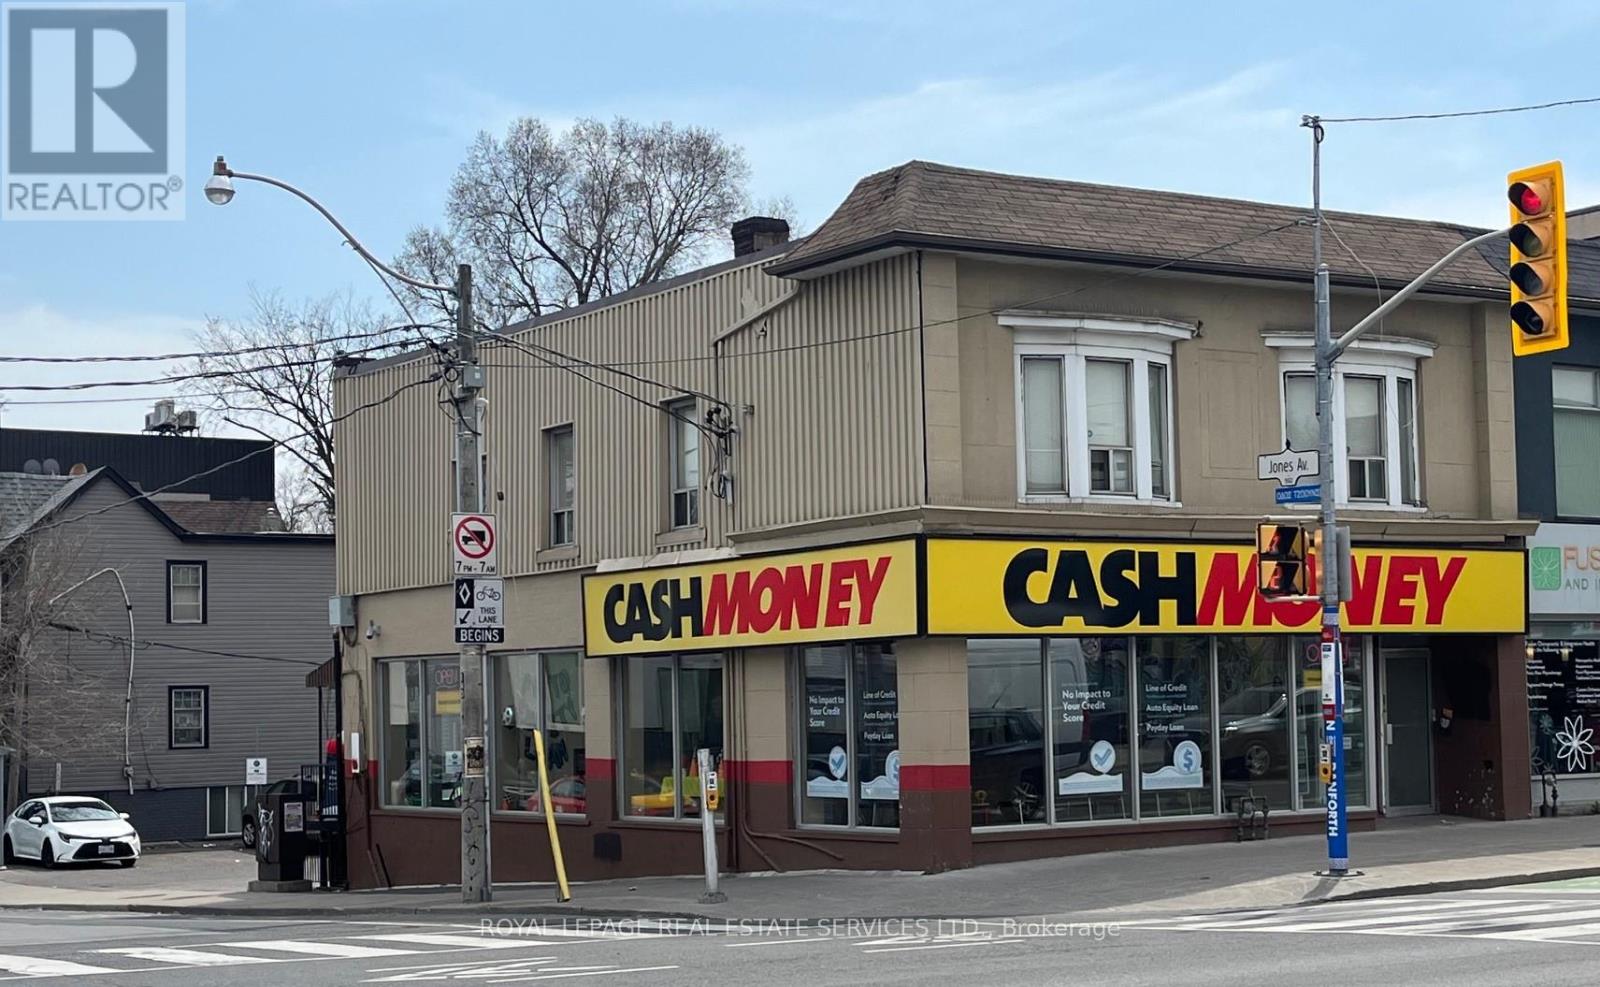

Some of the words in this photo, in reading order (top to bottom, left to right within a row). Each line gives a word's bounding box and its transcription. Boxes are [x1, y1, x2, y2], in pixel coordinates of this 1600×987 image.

[1268, 460, 1294, 474] Jones
[1565, 578, 1589, 591] AND
[480, 606, 496, 615] THIS
[478, 615, 497, 624] LANE
[460, 628, 499, 642] BEGINS
[1145, 683, 1159, 692] Line
[1160, 683, 1167, 692] of
[1167, 683, 1187, 692] Credit
[1062, 689, 1074, 699] No
[1075, 689, 1101, 700] Impact
[1102, 690, 1111, 698] to
[1062, 701, 1080, 710] Your
[1081, 700, 1106, 710] Credit
[1146, 703, 1162, 712] Auto
[1162, 703, 1182, 713] Equity
[1183, 703, 1198, 711] Loan
[1063, 713, 1084, 722] Score
[1146, 722, 1168, 733] Payday
[1169, 723, 1184, 731] Loan
